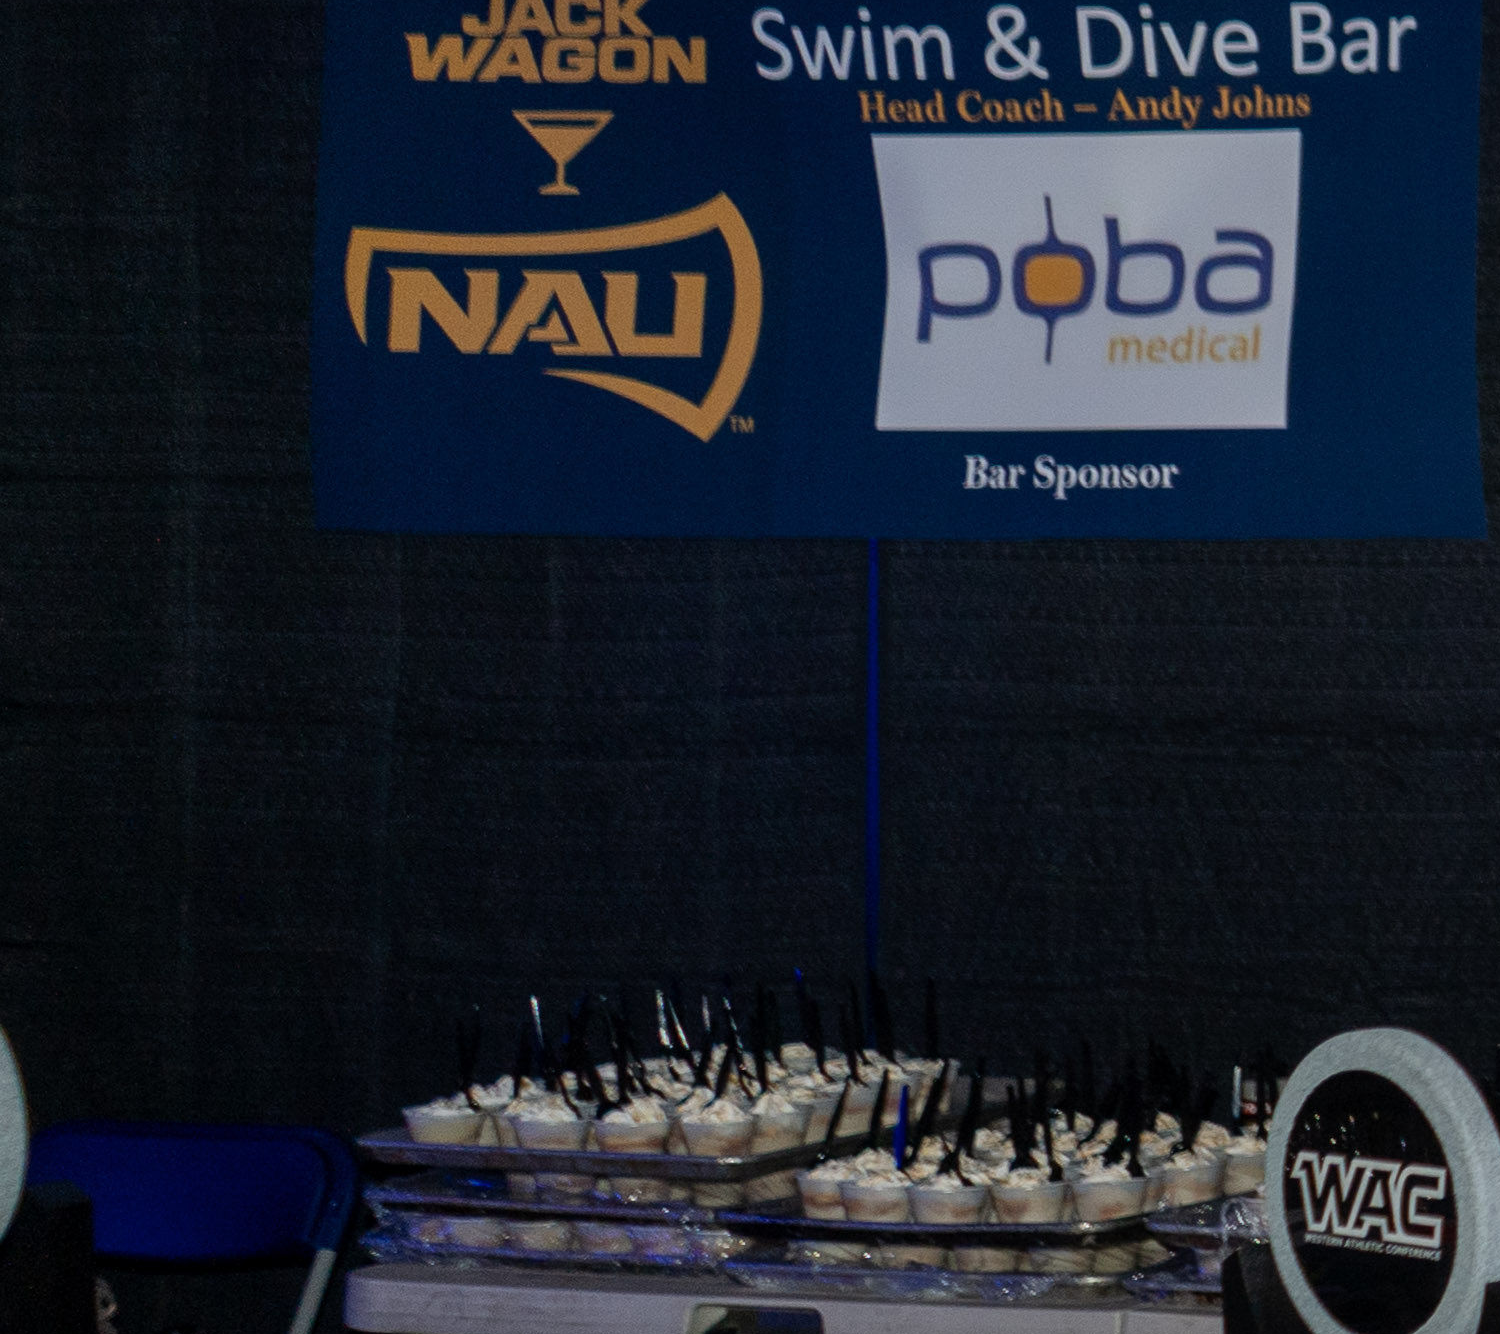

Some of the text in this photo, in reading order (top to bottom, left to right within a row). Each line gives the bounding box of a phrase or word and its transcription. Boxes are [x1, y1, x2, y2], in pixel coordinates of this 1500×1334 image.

[405, 35, 708, 85] WAGON
[751, 0, 1417, 82] Swim & Dive Bar
[858, 89, 948, 125] Head
[956, 88, 1065, 125] Coach
[1107, 85, 1201, 130] Andy
[1210, 85, 1312, 123] Johns
[916, 194, 1275, 365] poba
[387, 269, 707, 358] NAU
[1107, 323, 1263, 366] medical
[963, 455, 1180, 499] Bar Sponsor
[1290, 1150, 1448, 1250] WAC
